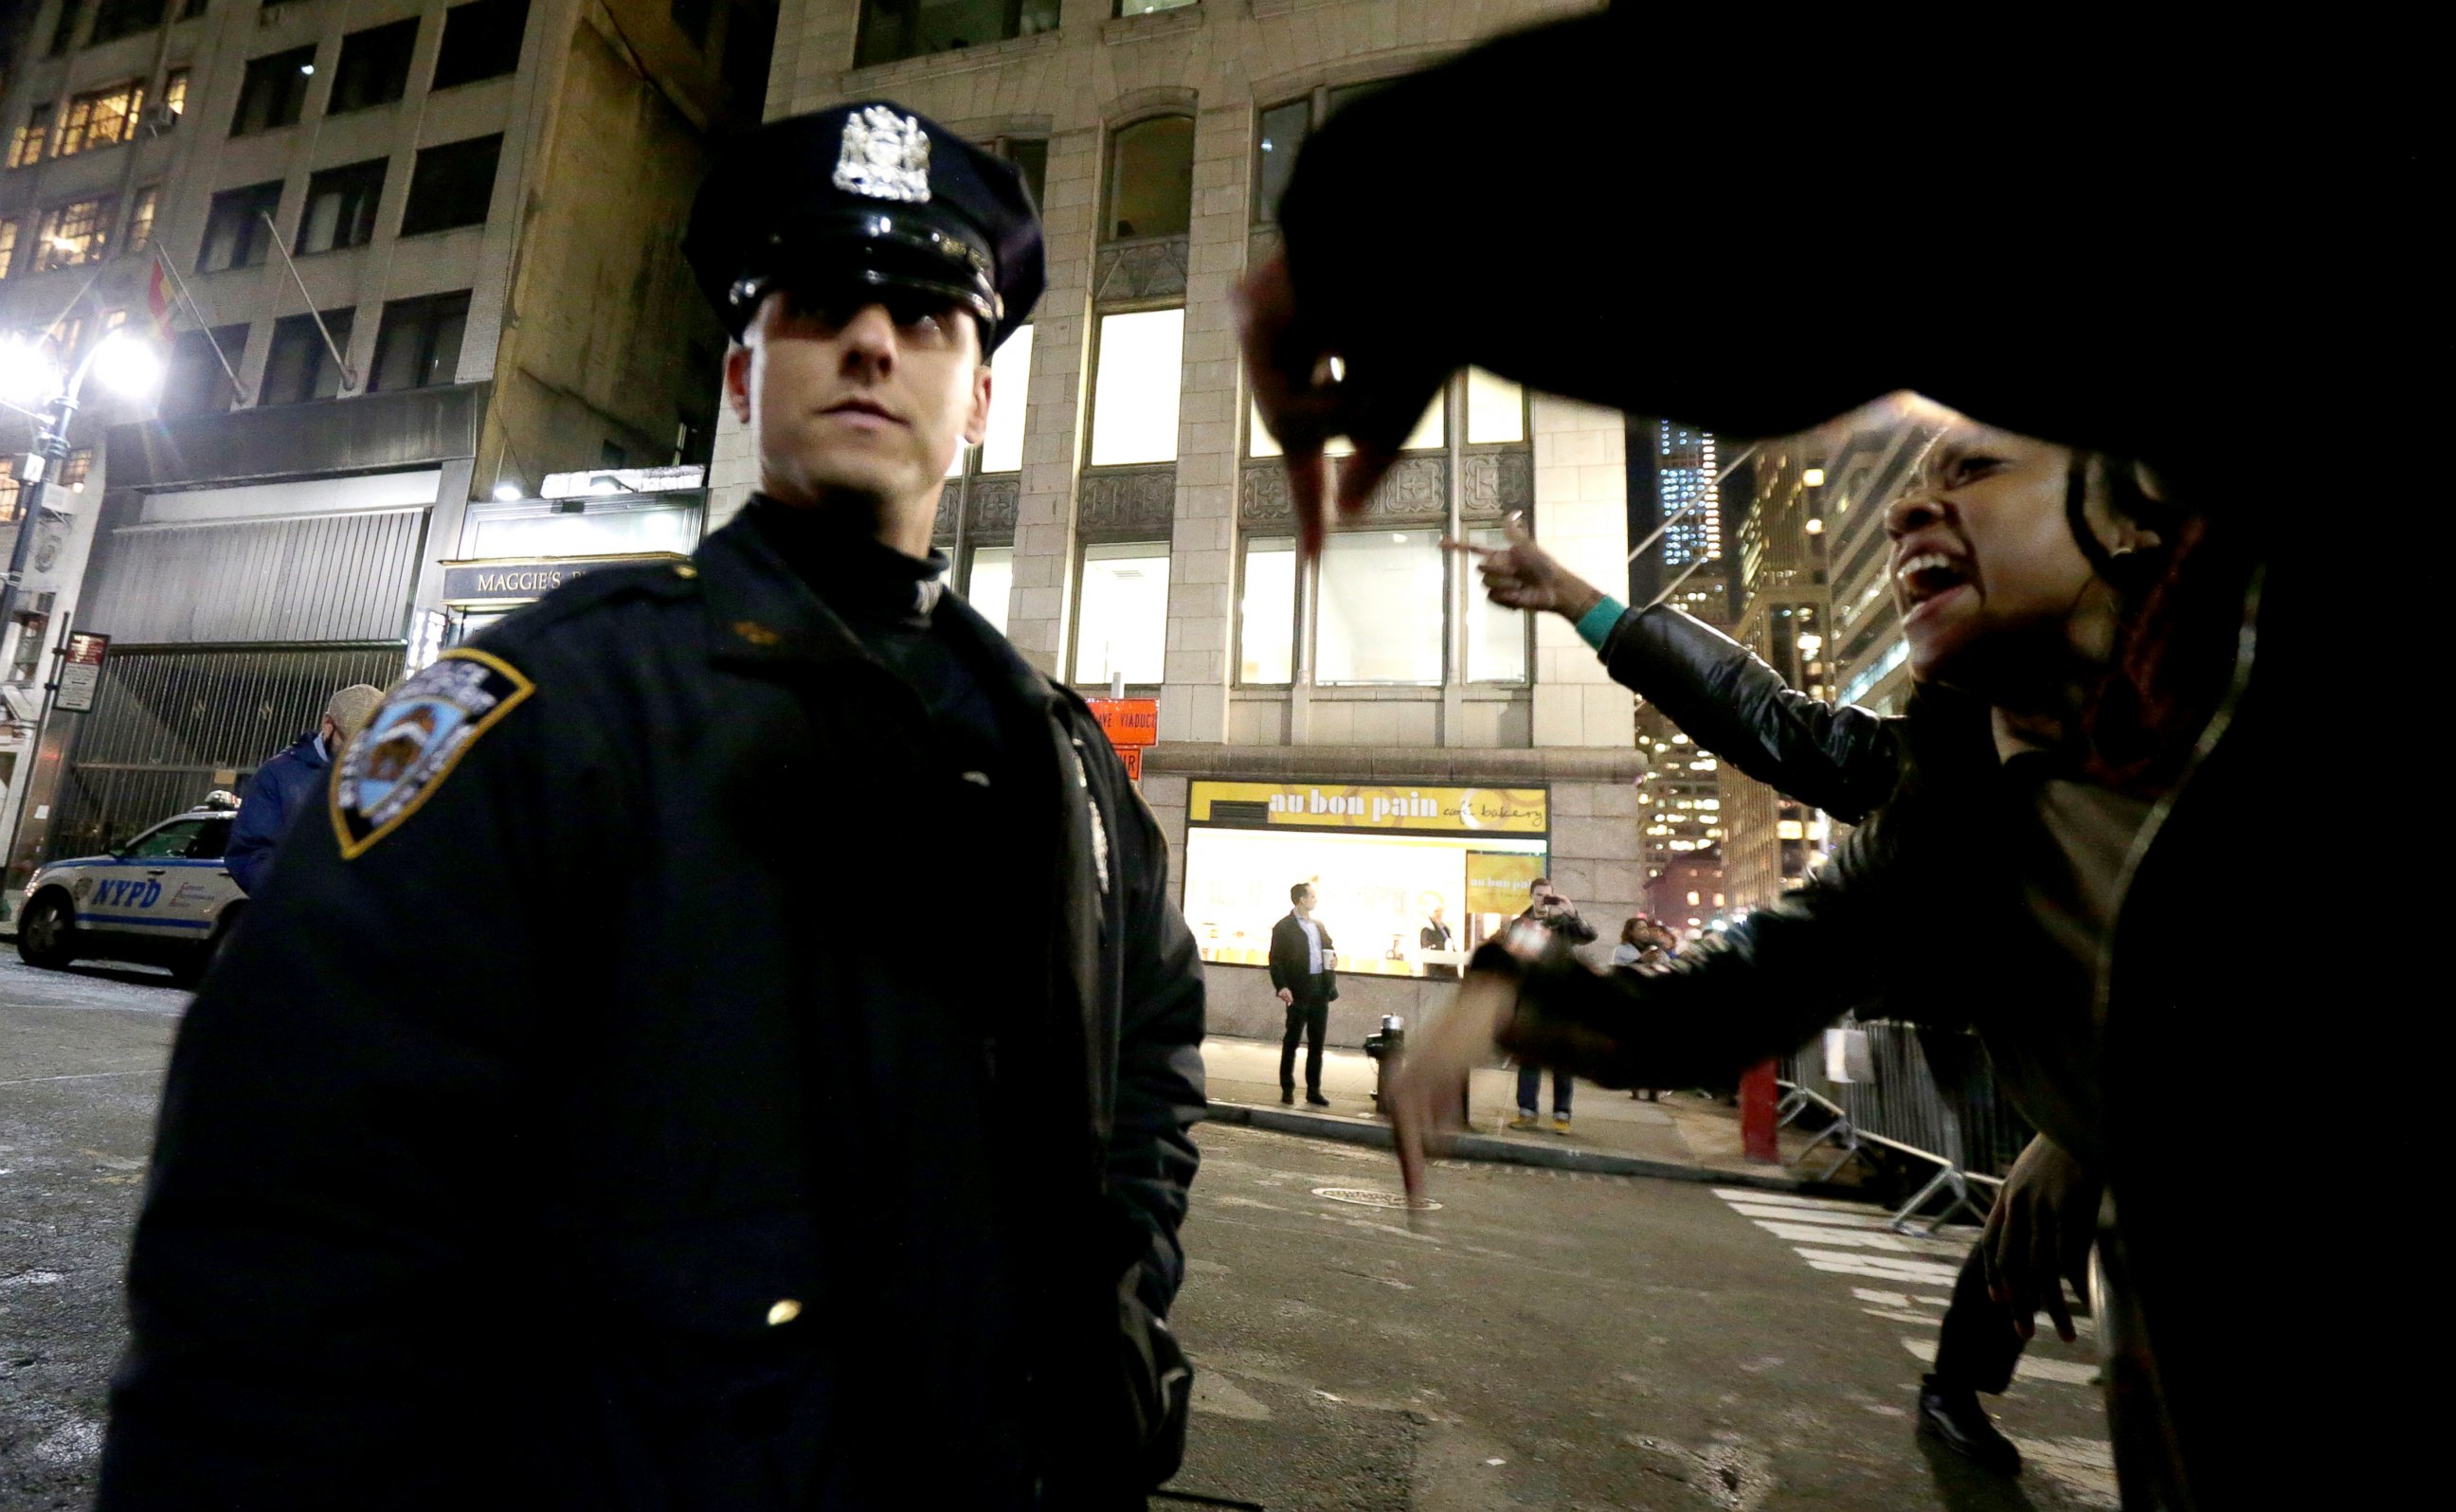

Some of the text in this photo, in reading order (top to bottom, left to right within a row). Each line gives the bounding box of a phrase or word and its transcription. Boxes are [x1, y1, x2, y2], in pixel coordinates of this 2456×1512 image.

[478, 571, 561, 591] MAGGIE'S
[1269, 793, 1304, 814] au
[1310, 789, 1364, 816] bon
[1372, 791, 1437, 822] pain
[1481, 802, 1543, 827] bakery
[93, 879, 162, 909] NYPD
[1513, 878, 1531, 891] pai
